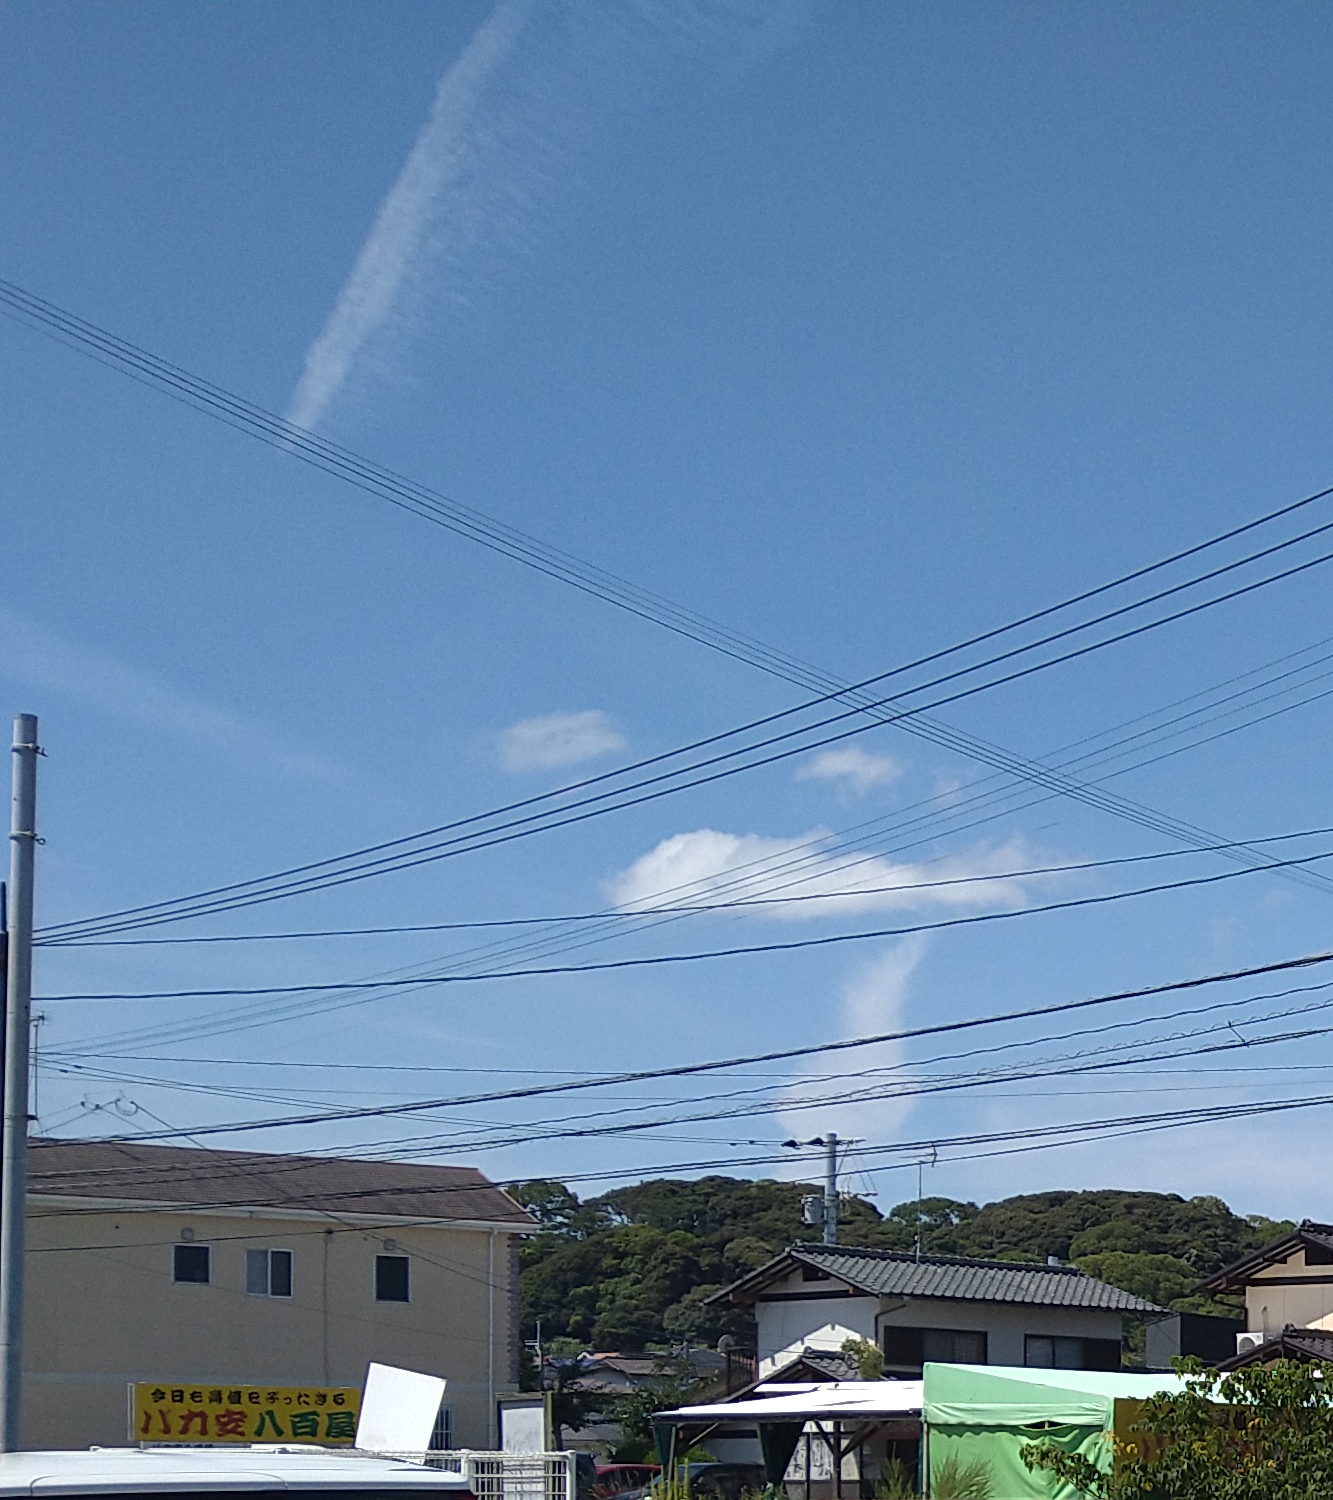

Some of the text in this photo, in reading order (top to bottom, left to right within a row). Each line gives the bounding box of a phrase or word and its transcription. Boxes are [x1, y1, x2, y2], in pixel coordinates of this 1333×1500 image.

[140, 1409, 355, 1437] バカ安八百屋
